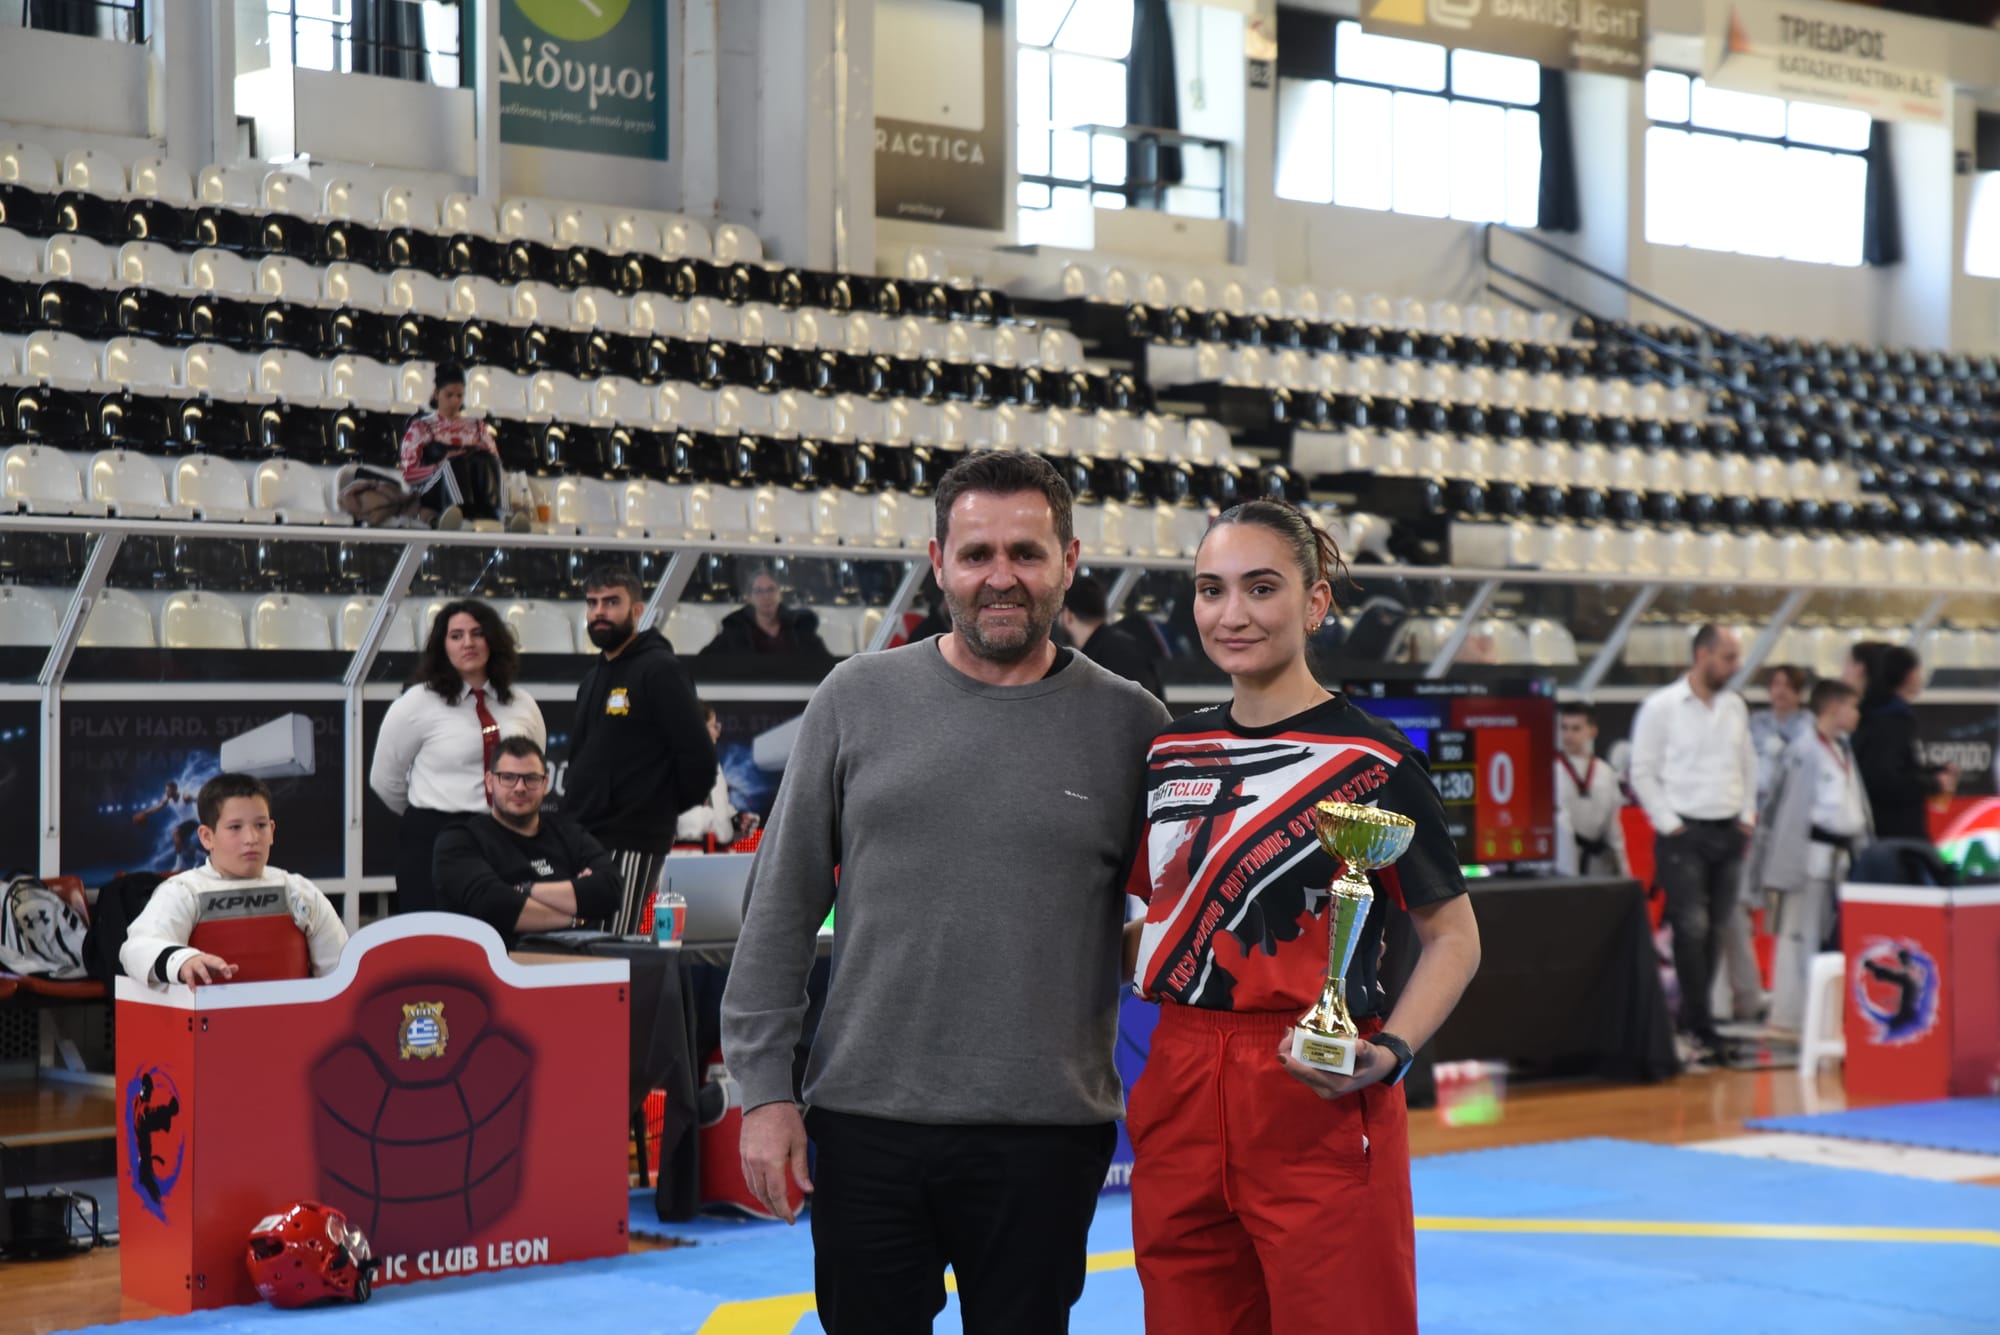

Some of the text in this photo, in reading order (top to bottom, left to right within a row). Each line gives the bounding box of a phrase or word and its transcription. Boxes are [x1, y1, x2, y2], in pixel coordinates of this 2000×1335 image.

[1780, 14, 1886, 61] ΤΡΙΕΔΡΟΣ
[498, 35, 656, 111] Δίδυμοι
[70, 717, 129, 736] PLAY
[1488, 752, 1515, 804] 0
[1218, 829, 1291, 903] RHYTHMIC
[1287, 764, 1389, 838] GYASTICS
[207, 893, 279, 911] KPNP
[417, 1246, 479, 1275] CLUB
[487, 1237, 549, 1267] LEON
